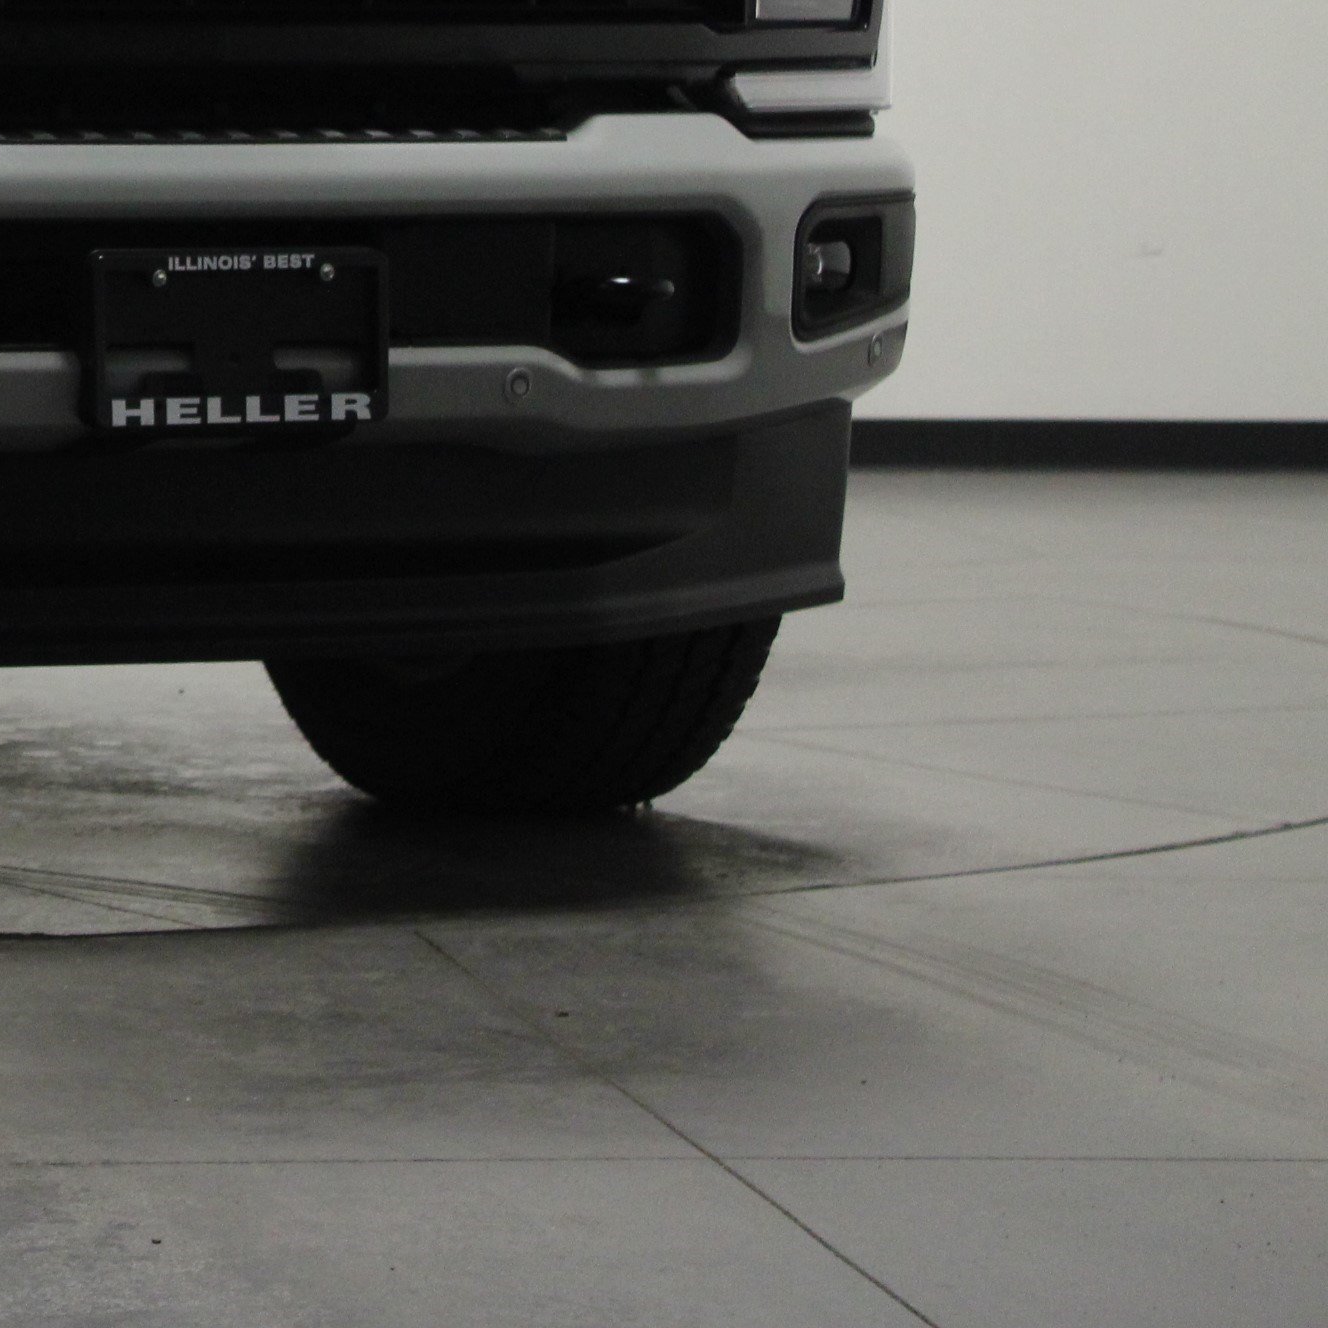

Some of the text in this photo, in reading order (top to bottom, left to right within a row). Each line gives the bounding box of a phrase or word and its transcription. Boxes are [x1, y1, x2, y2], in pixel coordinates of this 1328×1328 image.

[168, 253, 315, 272] ILLINOIS' BEST
[111, 392, 372, 428] HELLER
